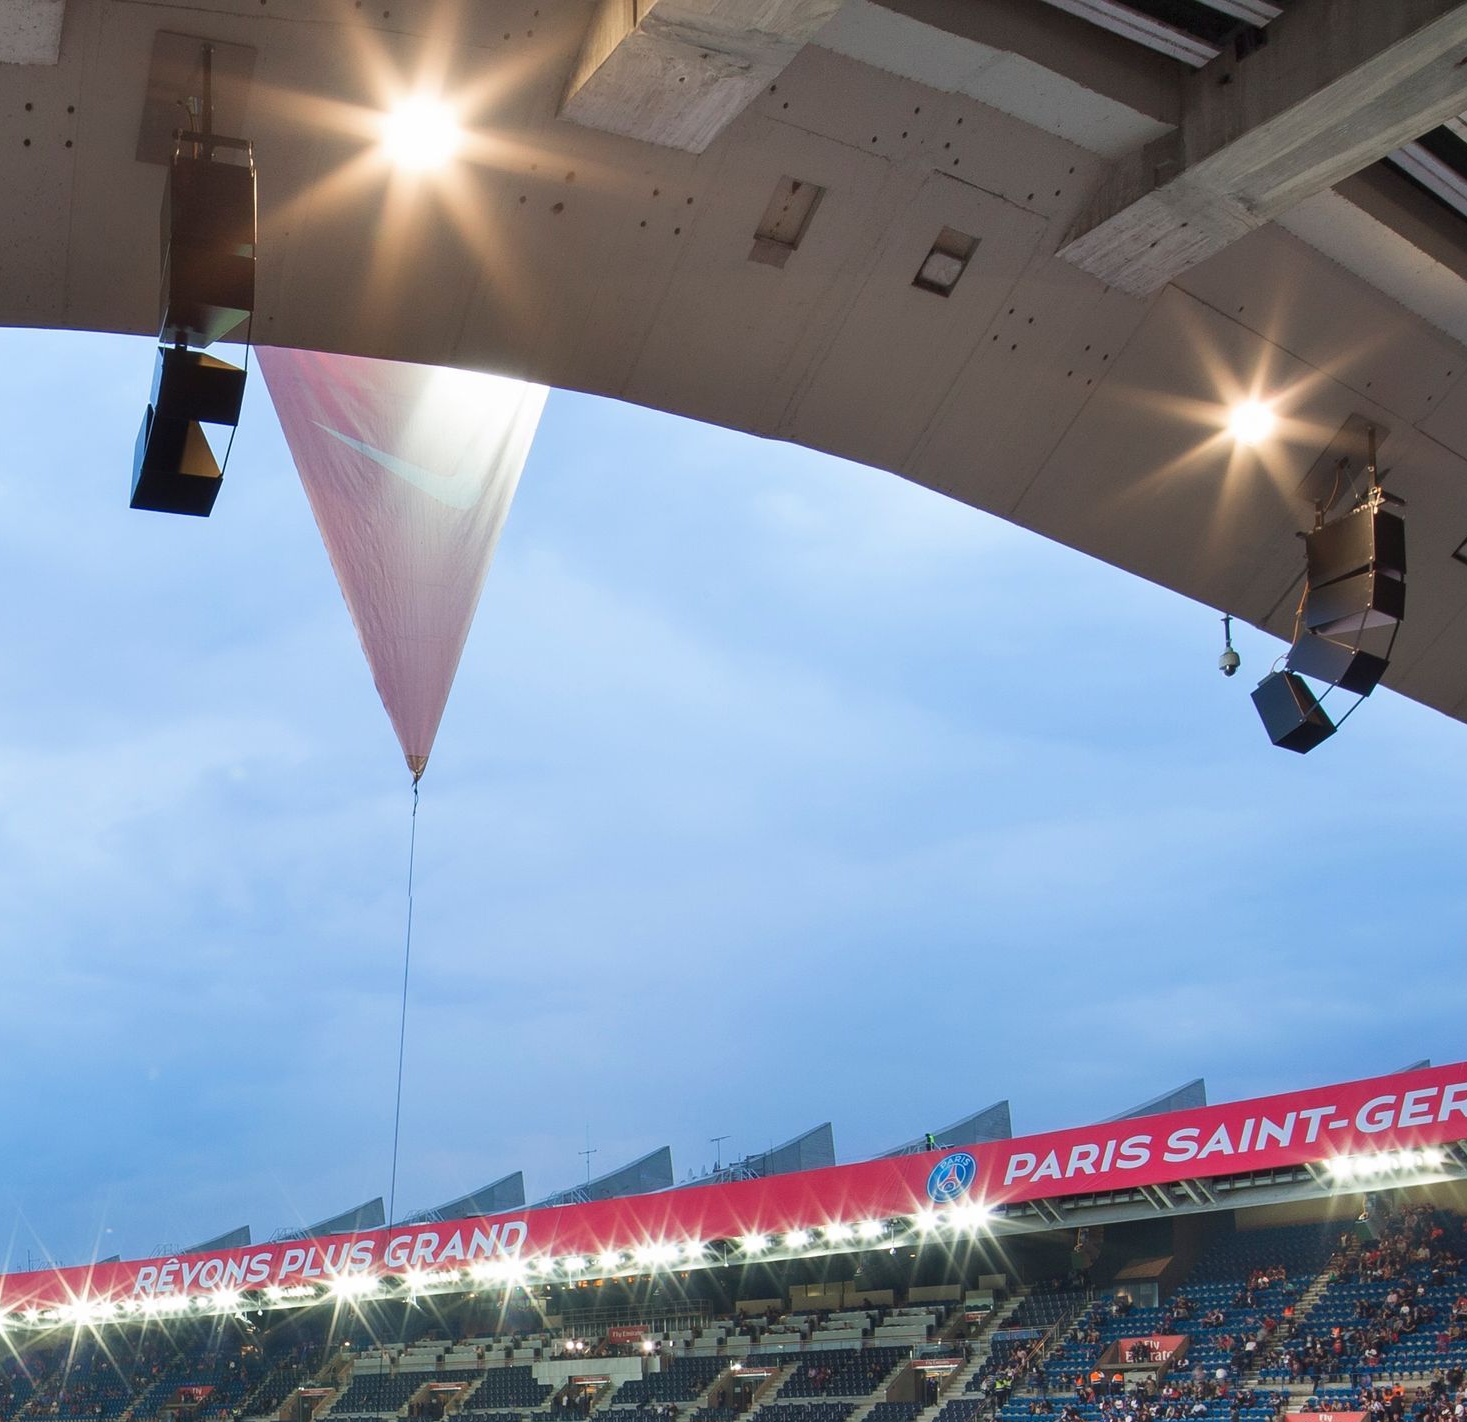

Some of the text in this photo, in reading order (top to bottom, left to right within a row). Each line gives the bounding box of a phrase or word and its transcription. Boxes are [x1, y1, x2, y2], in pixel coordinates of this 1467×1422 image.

[1003, 1132, 1152, 1187] PARIS
[134, 1222, 528, 1295] RÊVONS PLUS GRAND
[1319, 1414, 1333, 1422] Fly
